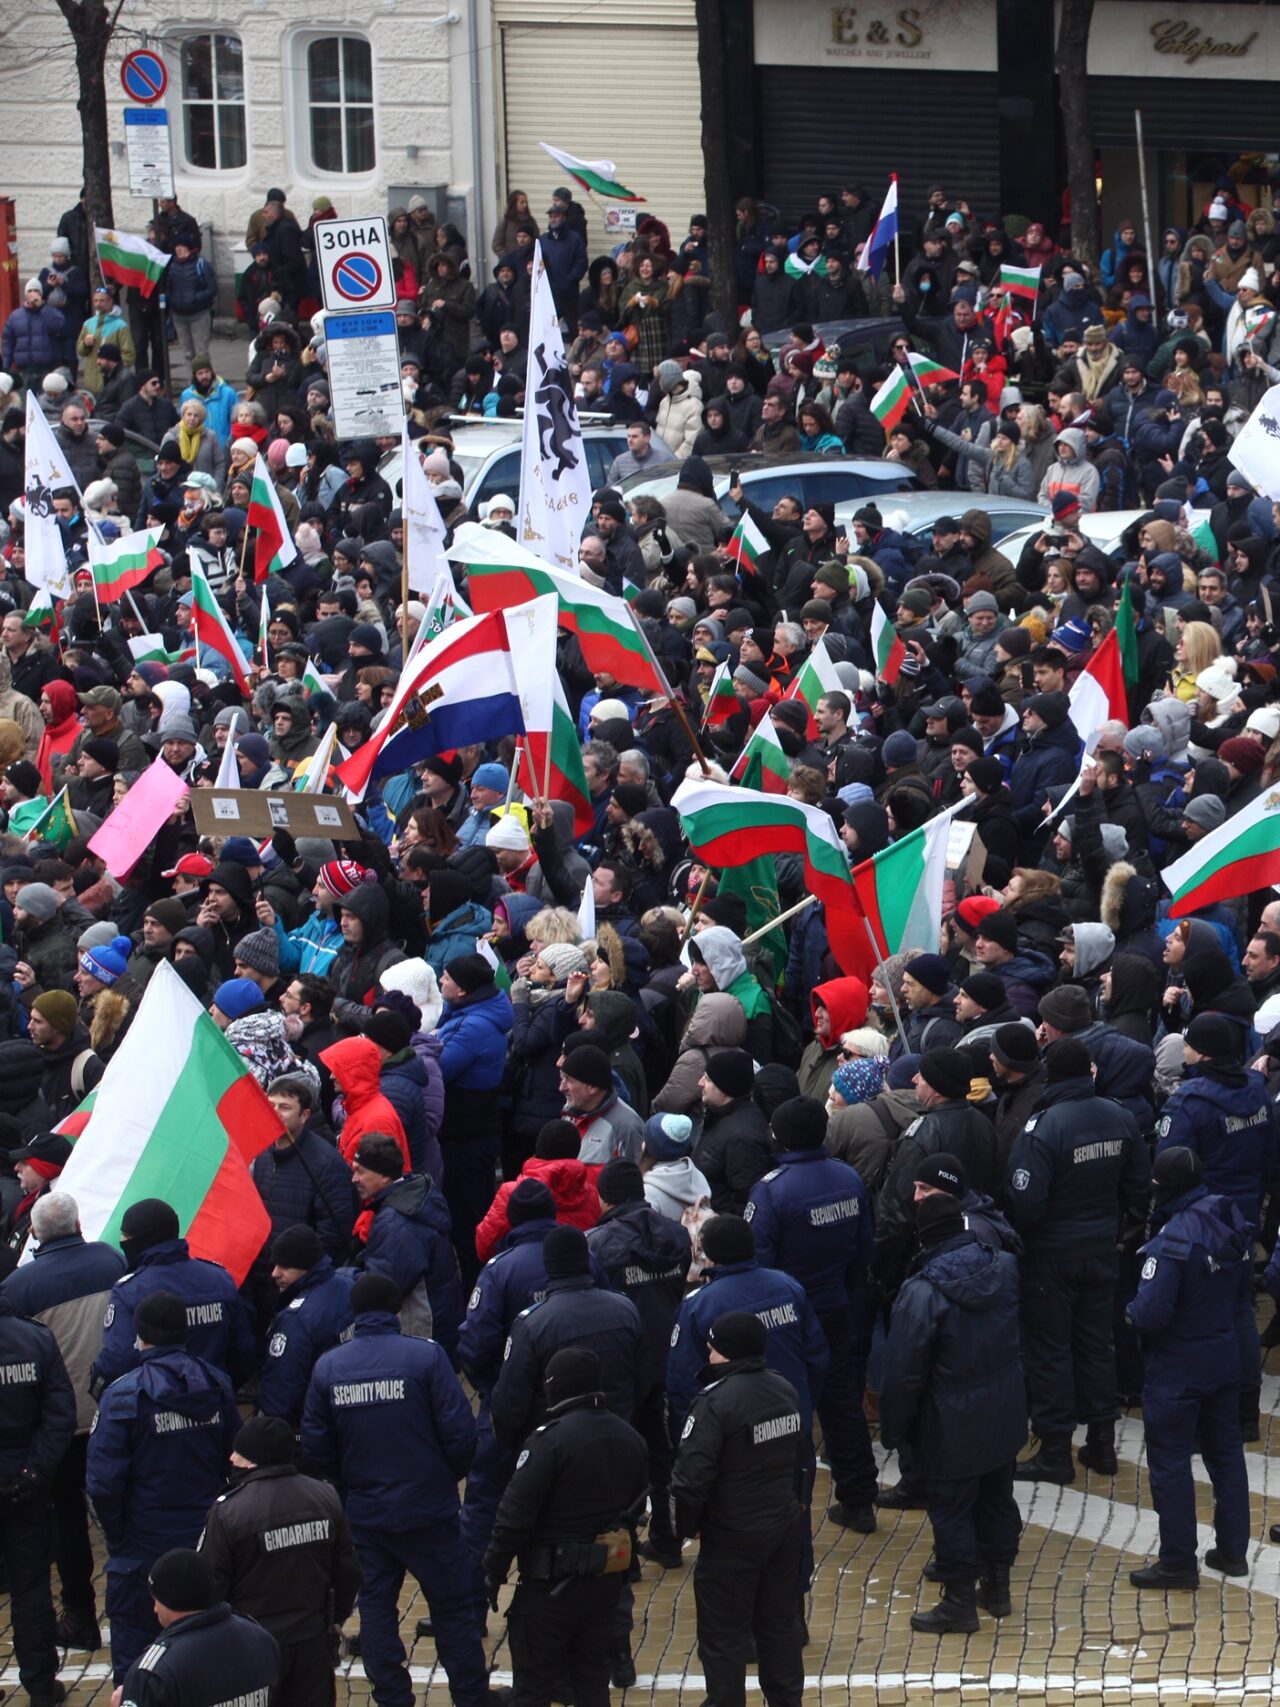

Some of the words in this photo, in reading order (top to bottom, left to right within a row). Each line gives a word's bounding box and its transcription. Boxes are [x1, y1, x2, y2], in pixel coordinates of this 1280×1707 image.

[831, 7, 858, 45] E
[866, 20, 890, 45] &
[896, 7, 922, 48] S
[826, 48, 862, 57] WATCHES
[1150, 19, 1259, 65] Chopard
[322, 227, 381, 250] ЗОНА
[1074, 1142, 1104, 1164] SECURITY
[811, 1203, 841, 1227] SECURITY
[197, 1302, 223, 1325] POLICE
[772, 1303, 798, 1327] POLICE
[6, 1362, 37, 1384] POLICE
[333, 1380, 375, 1406] SECURITY
[375, 1379, 405, 1400] POLICE
[753, 1411, 800, 1446] GENDARMERY
[264, 1519, 330, 1551] GENDARMERY
